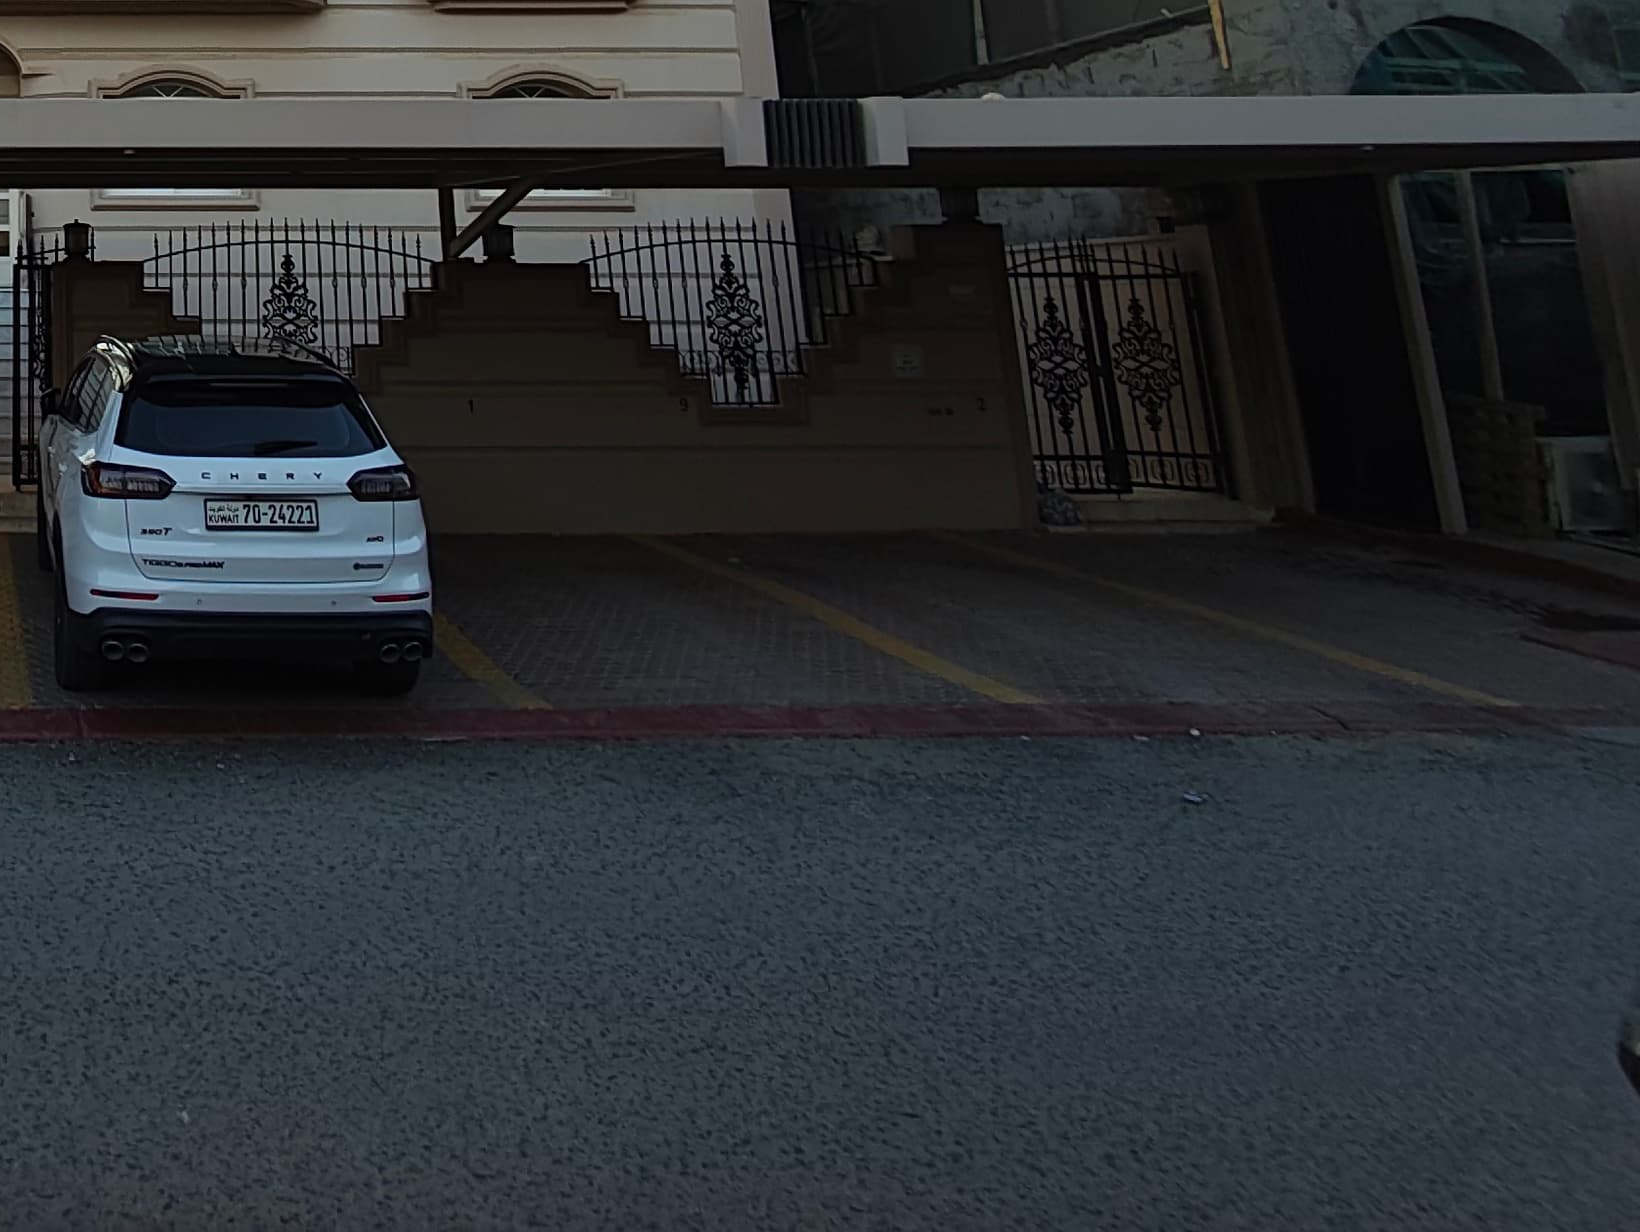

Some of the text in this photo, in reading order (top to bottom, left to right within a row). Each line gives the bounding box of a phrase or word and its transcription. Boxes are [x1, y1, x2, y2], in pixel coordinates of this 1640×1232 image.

[201, 471, 322, 481] CHERY
[208, 513, 239, 524] KUWAIT
[242, 503, 315, 524] 70-24221
